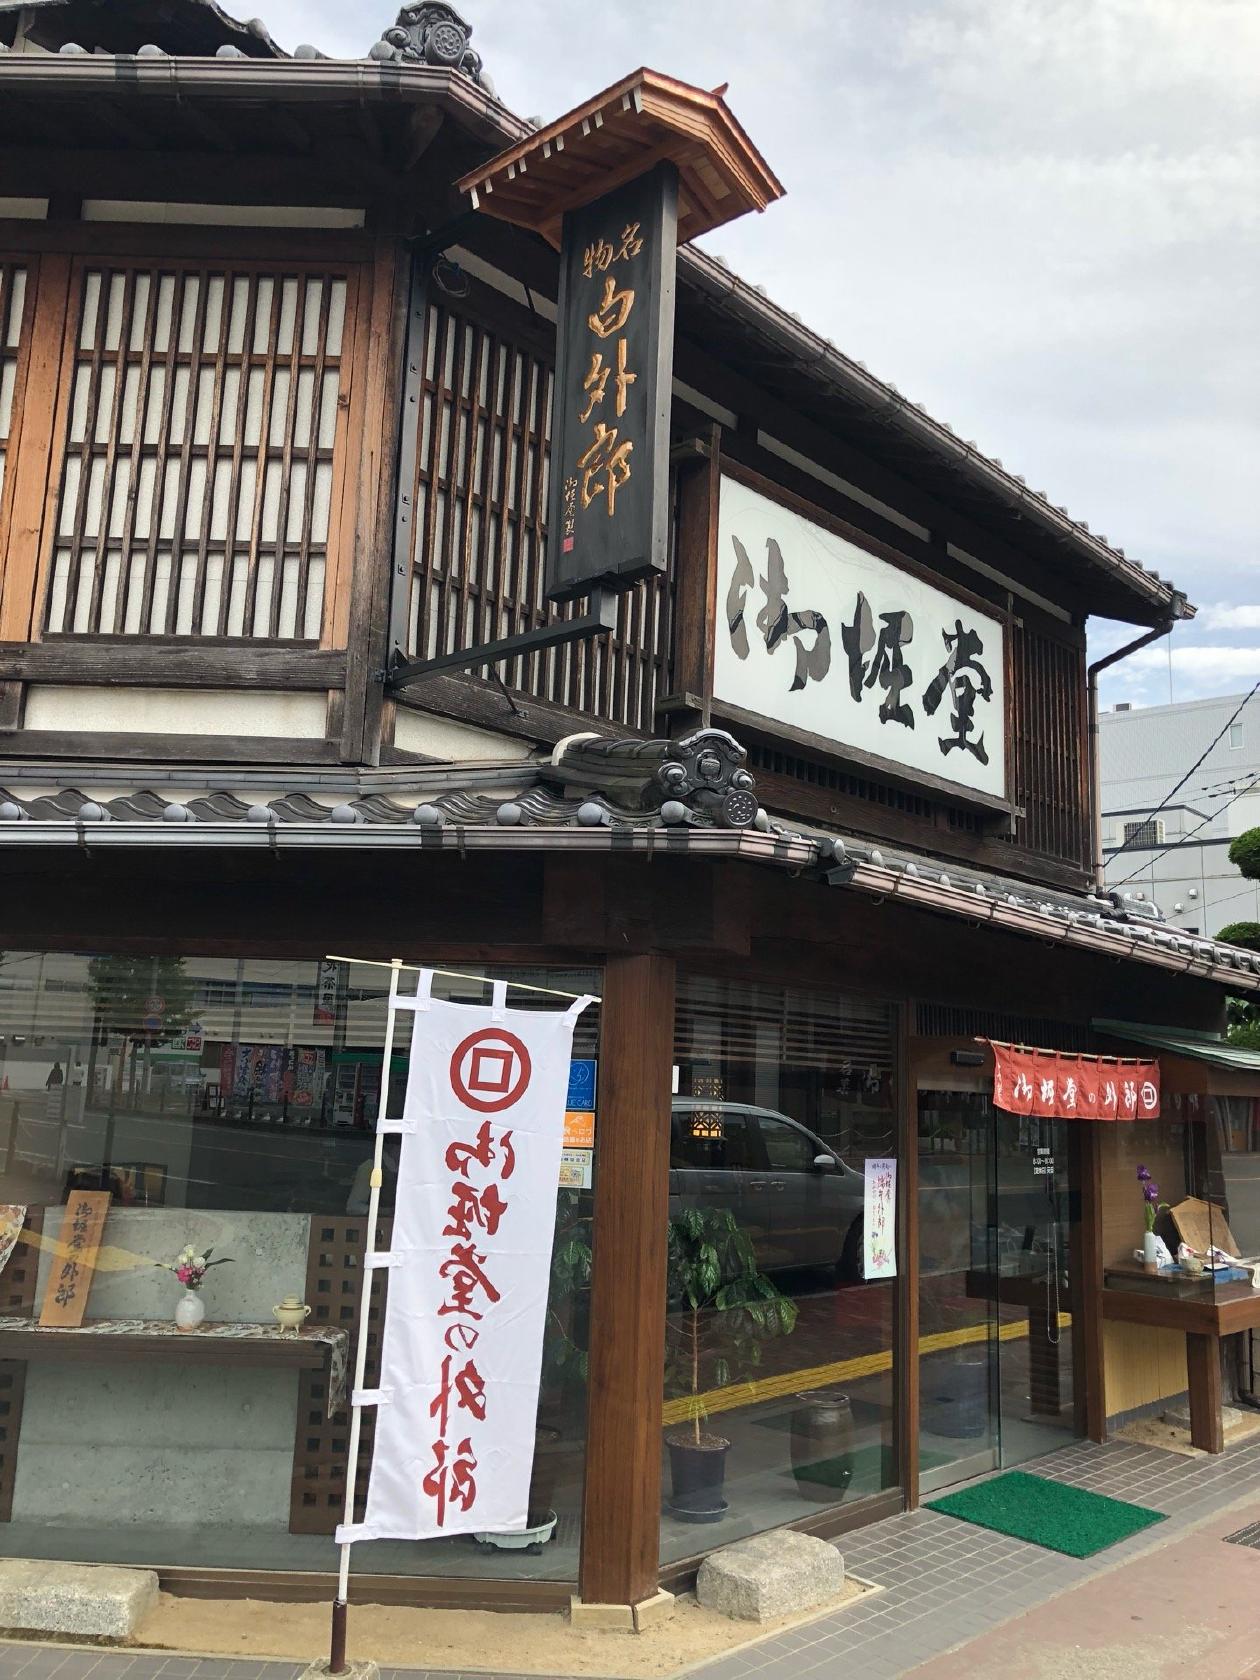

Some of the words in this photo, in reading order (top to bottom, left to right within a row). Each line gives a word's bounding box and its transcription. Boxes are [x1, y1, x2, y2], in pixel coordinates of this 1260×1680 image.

[583, 222, 644, 278] 名物
[577, 275, 637, 516] 白外郎
[727, 535, 993, 766] 御堀堂
[1014, 1073, 1137, 1111] 御堀堂の外郎
